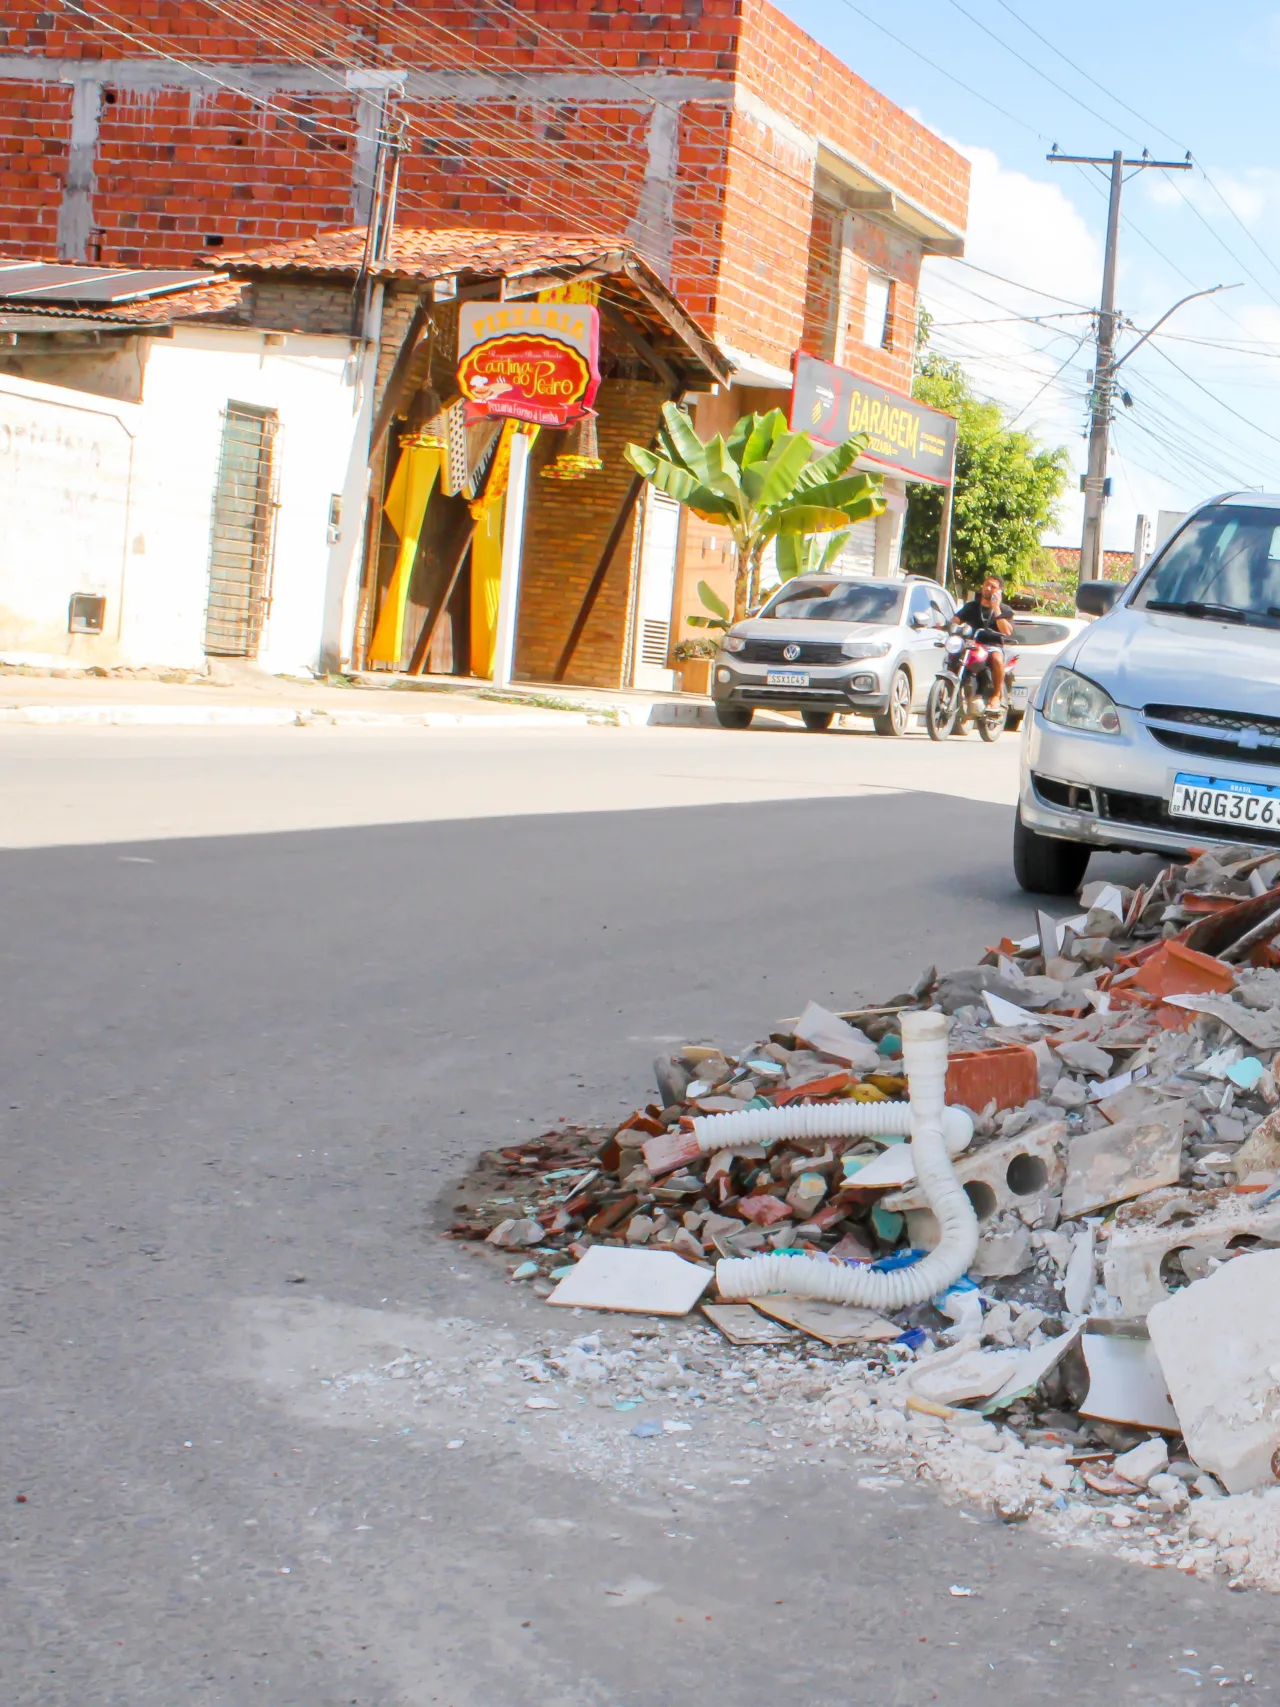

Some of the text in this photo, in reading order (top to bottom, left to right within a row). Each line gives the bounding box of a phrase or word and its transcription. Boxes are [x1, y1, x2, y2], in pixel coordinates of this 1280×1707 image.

[472, 307, 584, 341] PIZZARIA
[473, 353, 533, 376] Cantina
[522, 361, 573, 398] Pedro
[848, 390, 920, 459] GARAGEM
